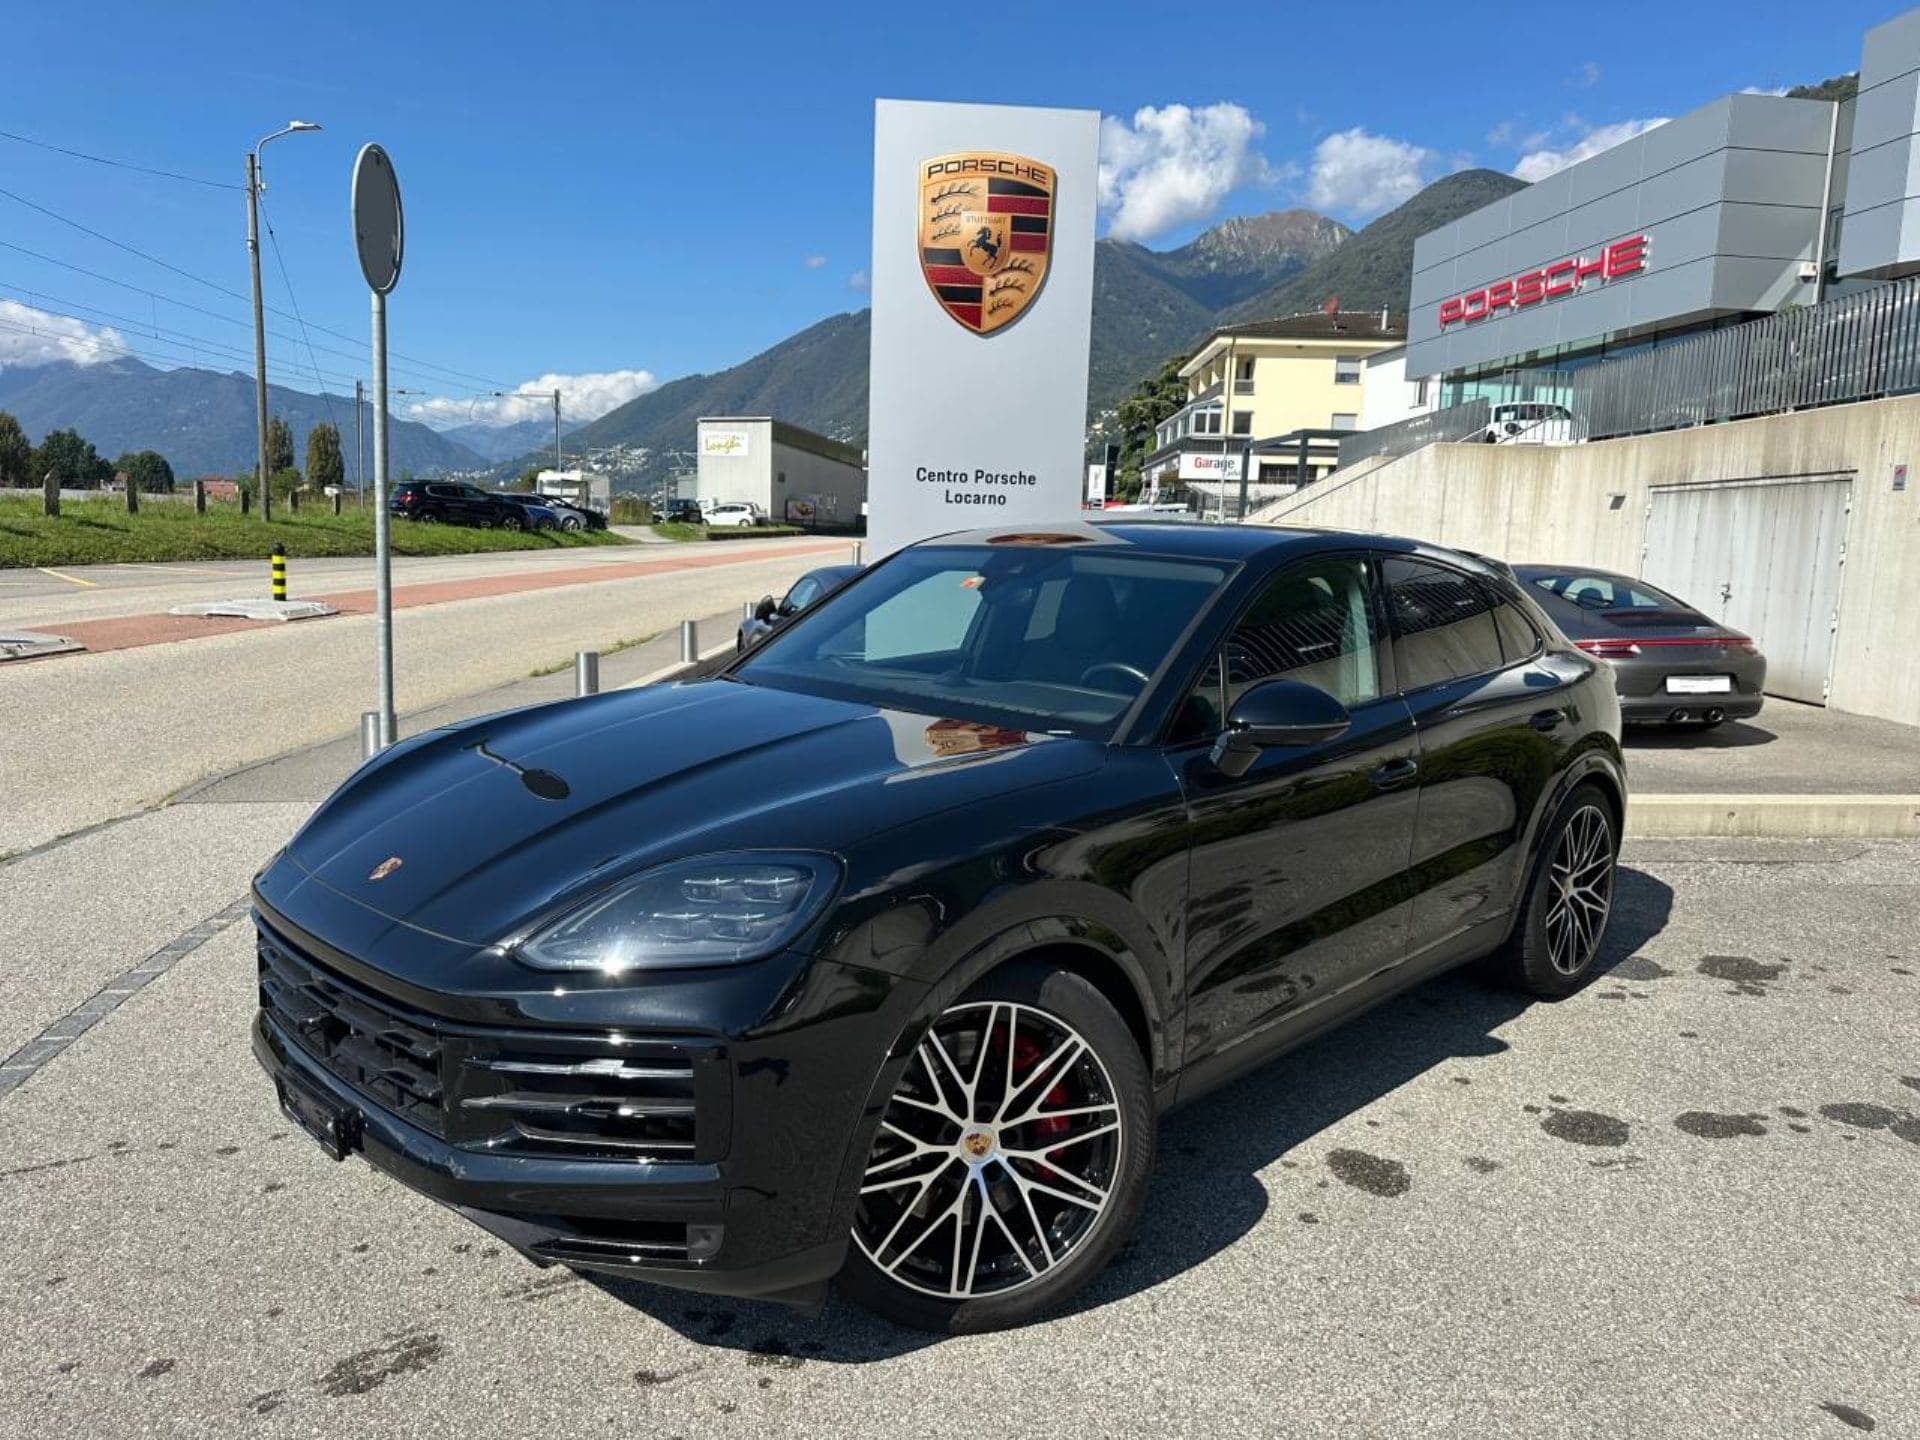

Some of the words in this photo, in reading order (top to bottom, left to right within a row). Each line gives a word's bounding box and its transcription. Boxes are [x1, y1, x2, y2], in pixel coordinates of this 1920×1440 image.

[927, 159, 1047, 185] PORSCHE
[1439, 235, 1649, 331] PORSCHE
[1194, 456, 1236, 472] Garage
[916, 466, 968, 483] Centro
[974, 468, 1037, 485] Porsche
[945, 489, 1007, 505] Locarno
